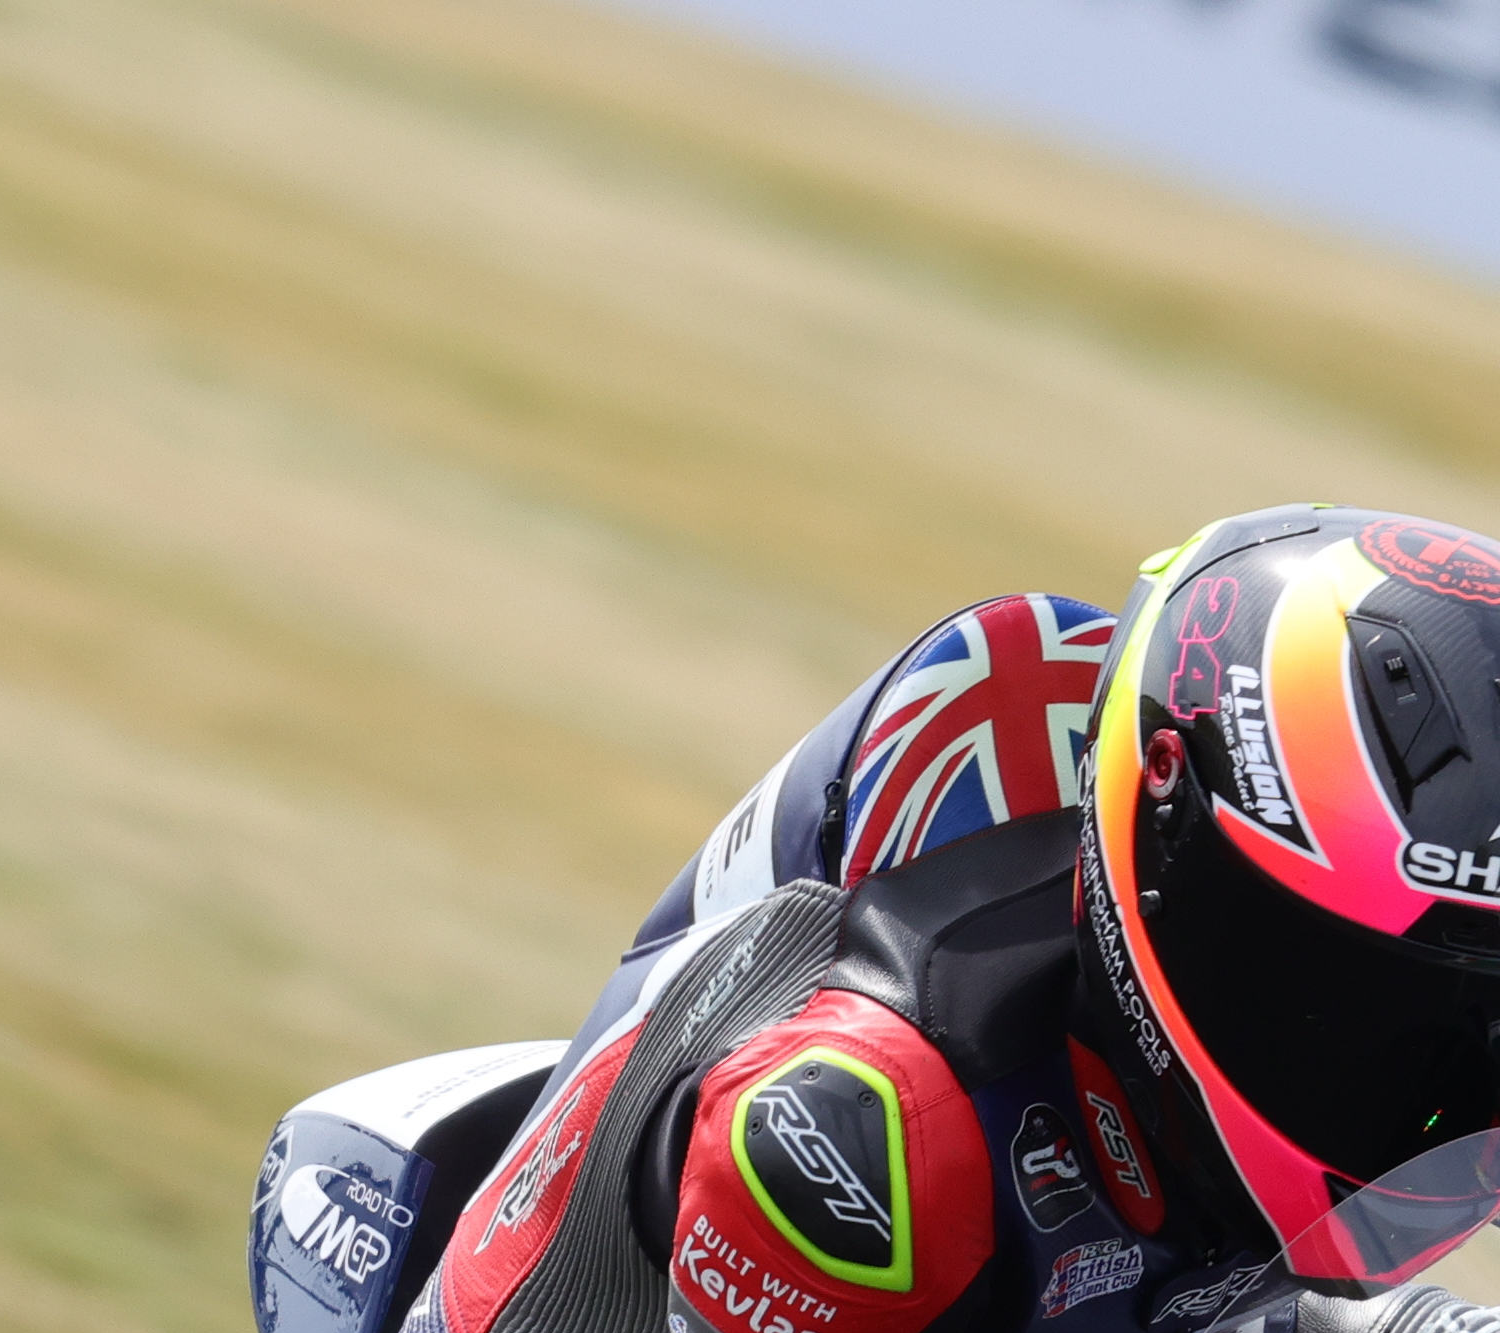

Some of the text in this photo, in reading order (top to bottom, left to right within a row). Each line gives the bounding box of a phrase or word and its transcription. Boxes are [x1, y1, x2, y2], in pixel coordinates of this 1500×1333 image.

[1226, 664, 1293, 826] ILLUSION
[1126, 977, 1171, 1072] POOLS
[752, 1085, 891, 1241] RST
[1085, 1091, 1151, 1198] RST
[346, 1178, 414, 1228] ROAD TO
[693, 1215, 837, 1323] BUILT WITH
[1067, 1245, 1143, 1285] British
[1111, 1271, 1140, 1292] Cup
